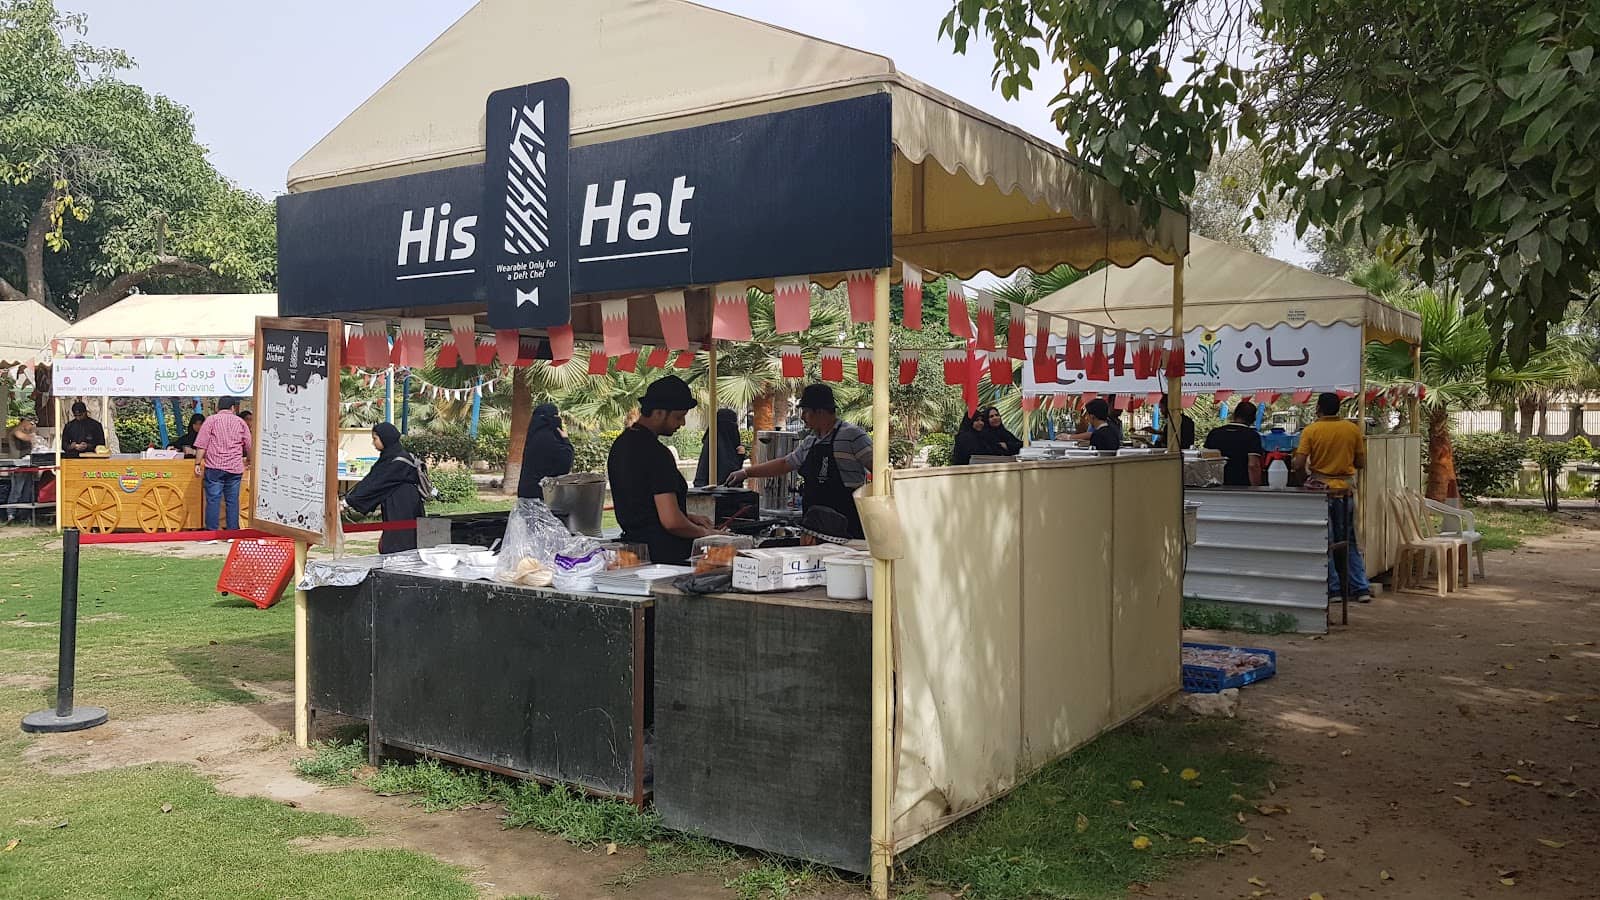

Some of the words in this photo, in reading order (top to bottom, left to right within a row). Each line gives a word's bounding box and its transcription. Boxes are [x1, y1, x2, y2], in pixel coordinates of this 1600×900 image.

[397, 202, 478, 266] His
[579, 175, 695, 247] Hat
[496, 262, 527, 273] Wearable
[528, 260, 545, 270] Only
[546, 259, 557, 268] for
[513, 270, 529, 280] Deft
[529, 269, 546, 279] Chef
[266, 343, 286, 354] HisHat
[266, 353, 285, 362] Dishes
[190, 368, 216, 379] فروت
[154, 382, 176, 392] Fruit
[178, 382, 215, 392] Craving
